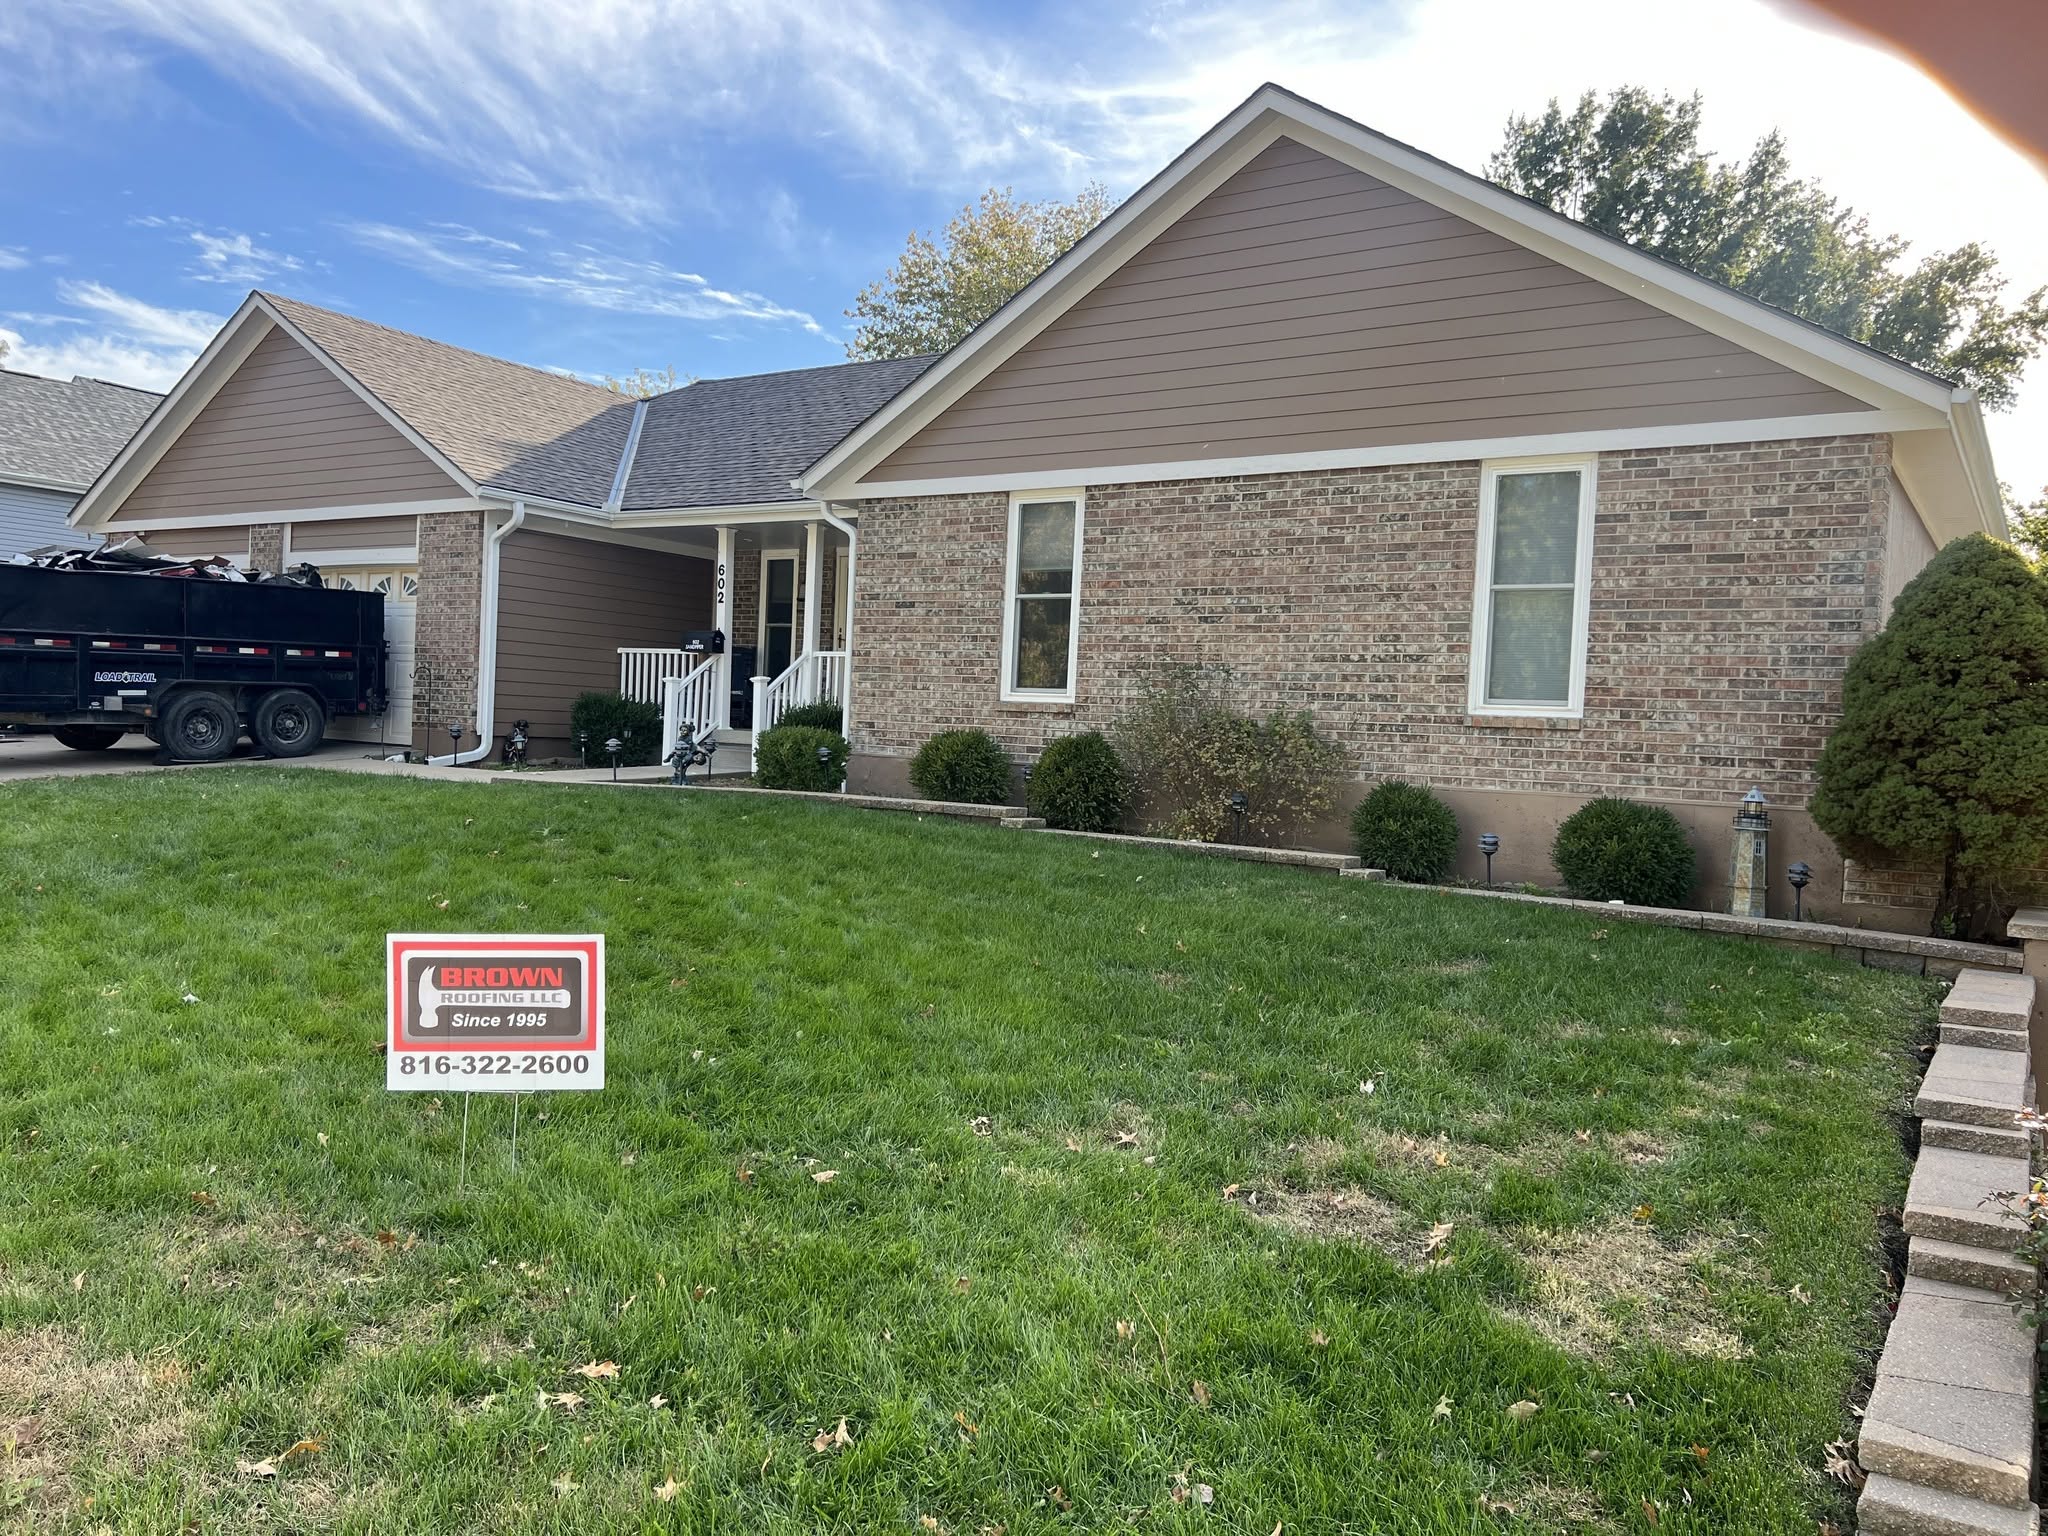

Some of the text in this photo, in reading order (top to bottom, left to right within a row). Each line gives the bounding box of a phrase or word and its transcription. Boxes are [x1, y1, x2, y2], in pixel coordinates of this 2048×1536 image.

[717, 564, 725, 604] 602
[94, 671, 157, 683] LOAD TRAIL
[440, 967, 563, 987] BROWN
[440, 992, 562, 1004] ROOFING LLC
[452, 1013, 547, 1027] Since 1995
[400, 1055, 589, 1075] 816-322-2600
